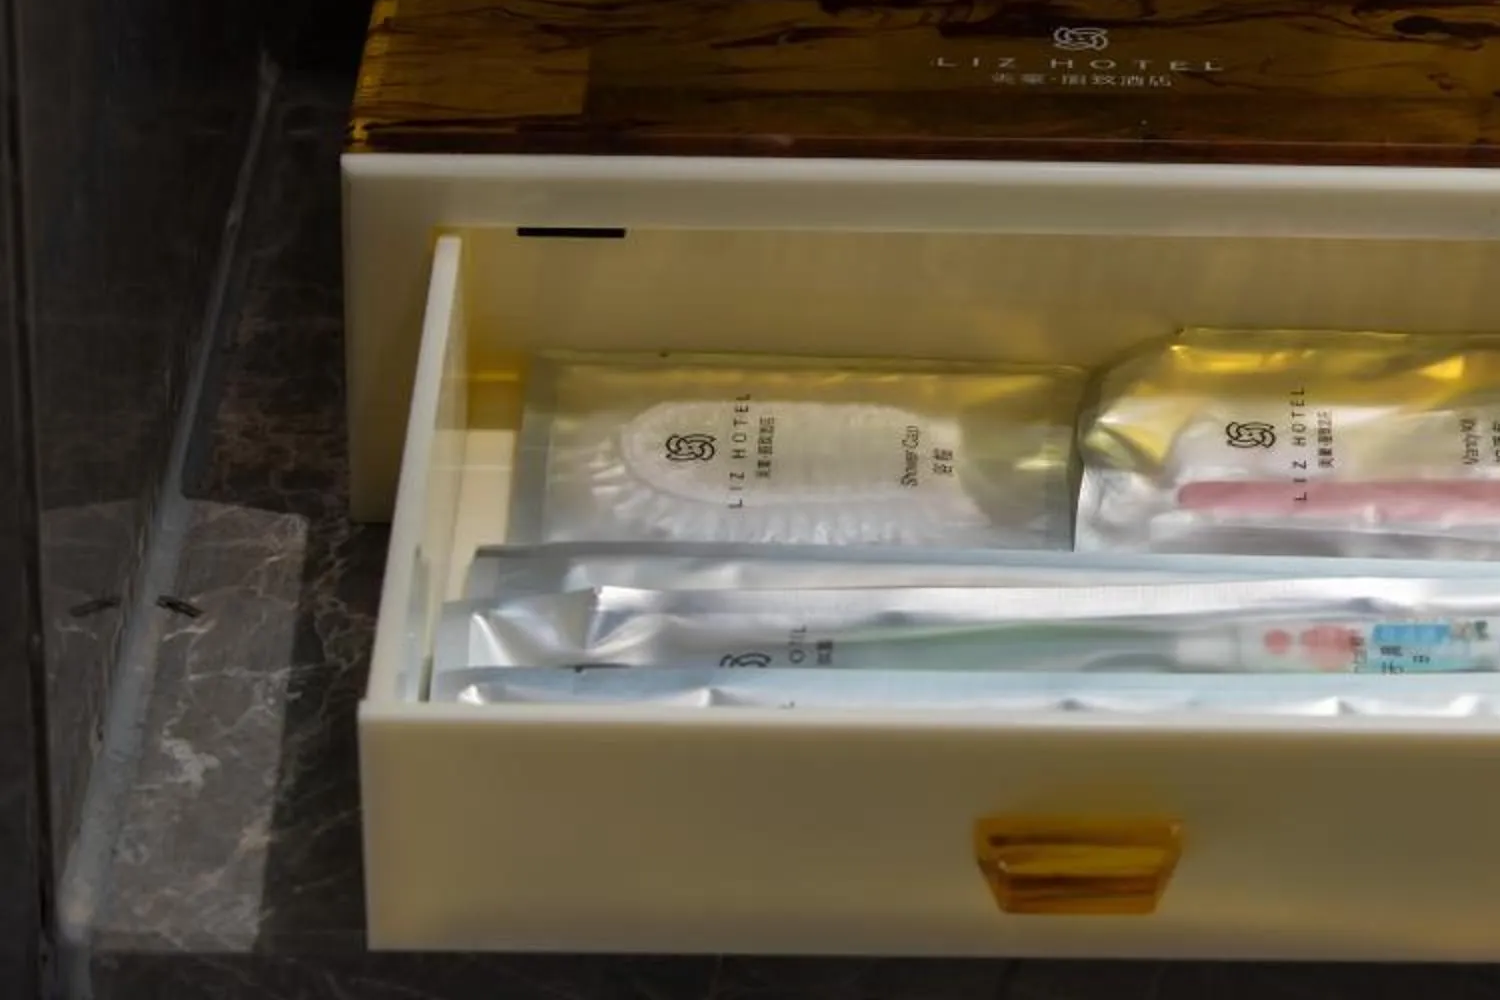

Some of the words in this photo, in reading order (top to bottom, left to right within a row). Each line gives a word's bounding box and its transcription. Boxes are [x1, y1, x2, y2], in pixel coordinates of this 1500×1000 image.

[936, 57, 1017, 69] LIZ
[1050, 57, 1225, 71] HOTEL
[732, 393, 751, 459] HOTEL
[1290, 387, 1306, 447] HOTEL
[728, 471, 744, 508] LIZ
[1291, 460, 1307, 502] LIZ
